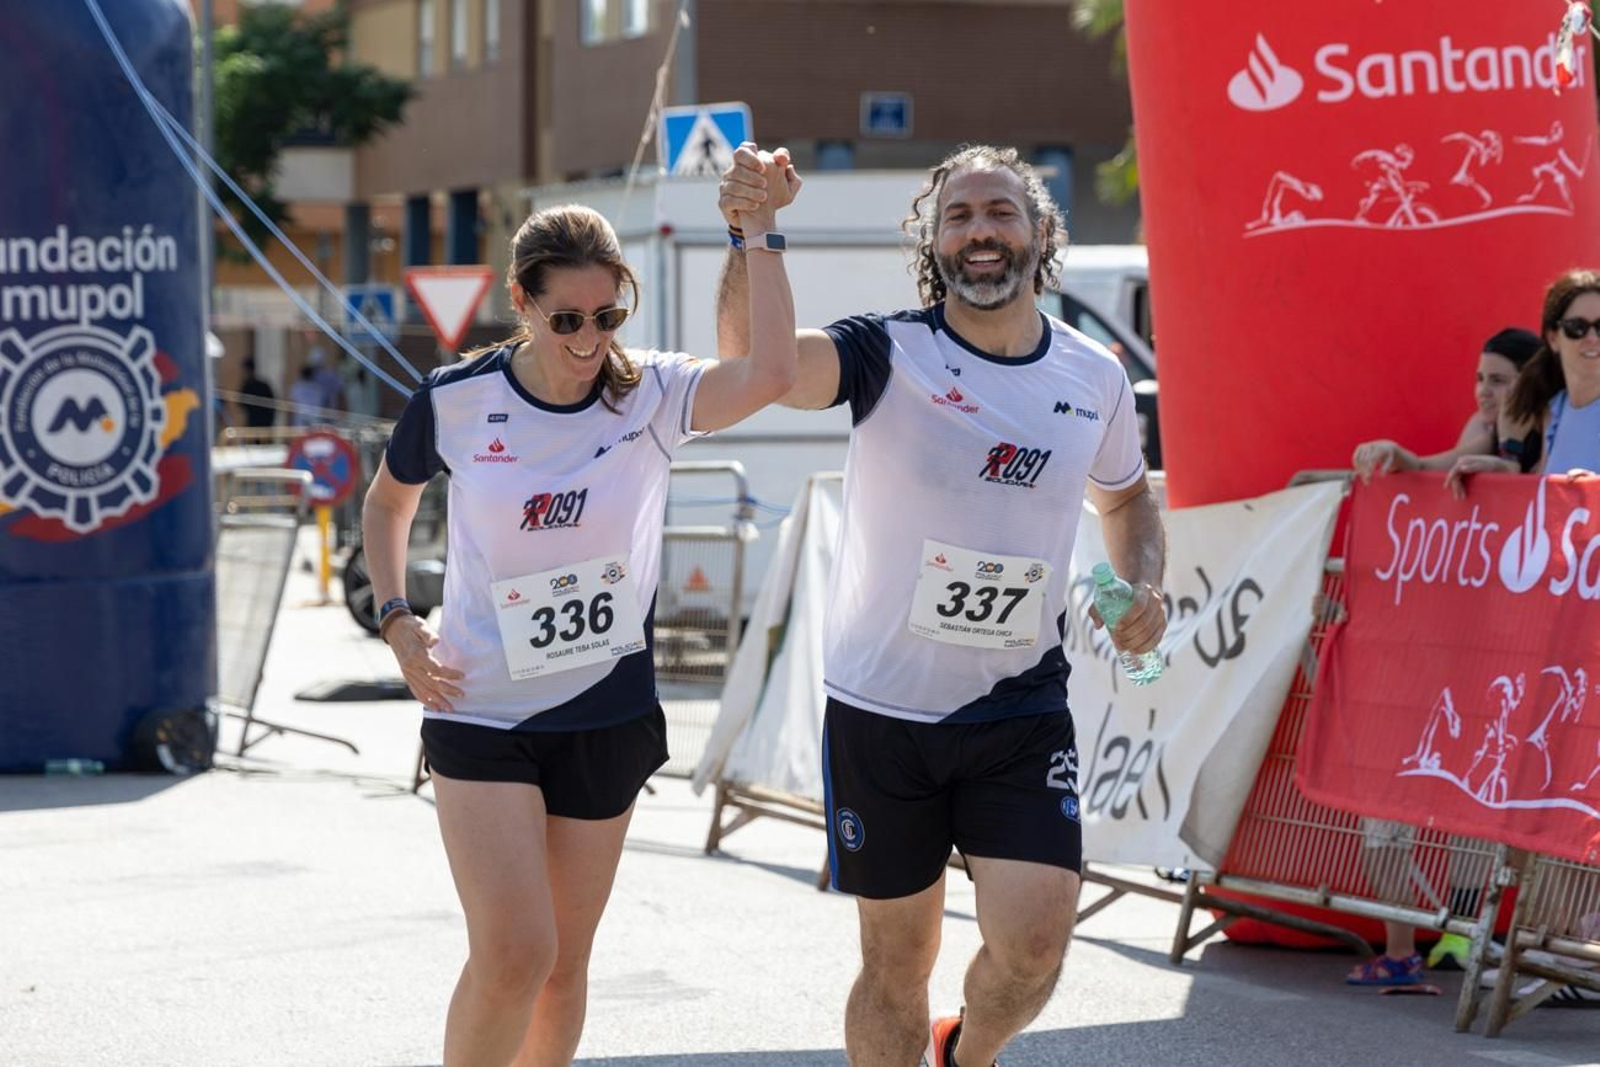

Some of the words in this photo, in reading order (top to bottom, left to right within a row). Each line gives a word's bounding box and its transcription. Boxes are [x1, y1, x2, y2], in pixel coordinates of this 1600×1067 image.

[1, 271, 145, 331] mupol
[472, 453, 519, 463] Santander
[1375, 493, 1499, 606] Sports
[529, 591, 614, 649] 336
[936, 581, 1030, 624] 337
[575, 643, 590, 653] TEBA
[591, 638, 610, 650] SOLAS
[971, 627, 995, 636] ORTEGA
